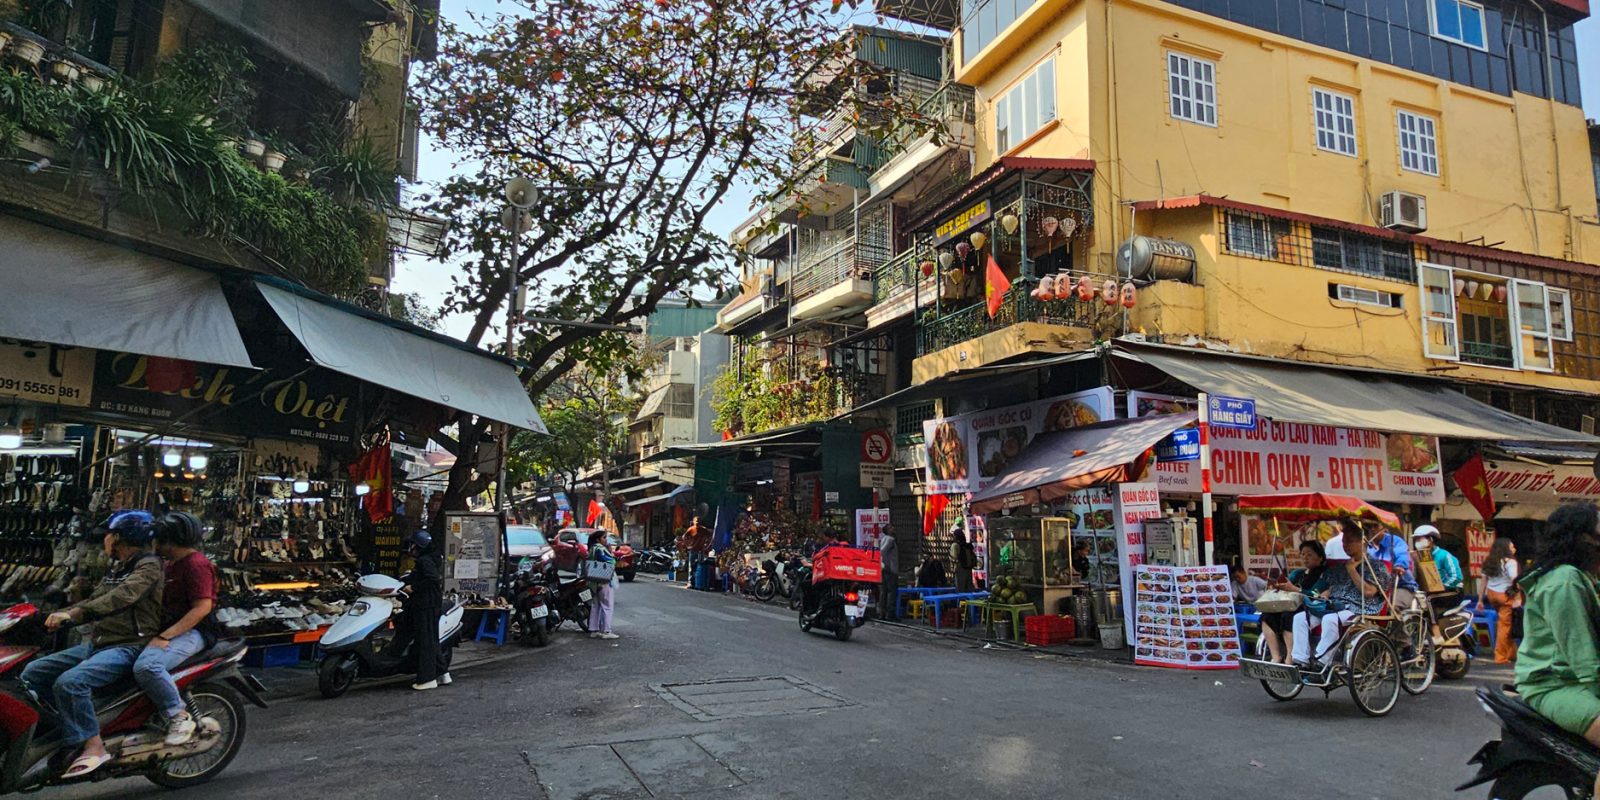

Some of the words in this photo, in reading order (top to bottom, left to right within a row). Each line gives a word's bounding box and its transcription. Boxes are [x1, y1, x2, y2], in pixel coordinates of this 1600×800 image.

[24, 382, 55, 395] 5555
[59, 388, 80, 399] 981
[1212, 409, 1234, 423] HÀNG
[1235, 411, 1252, 424] GIẤY
[1156, 461, 1189, 473] BITTET
[1212, 448, 1261, 485] CHIM
[1267, 453, 1311, 490] QUAY
[1329, 456, 1384, 491] BITTET
[1393, 475, 1415, 486] CHIM
[1417, 476, 1436, 488] QUAY
[1556, 476, 1594, 494] CHIM
